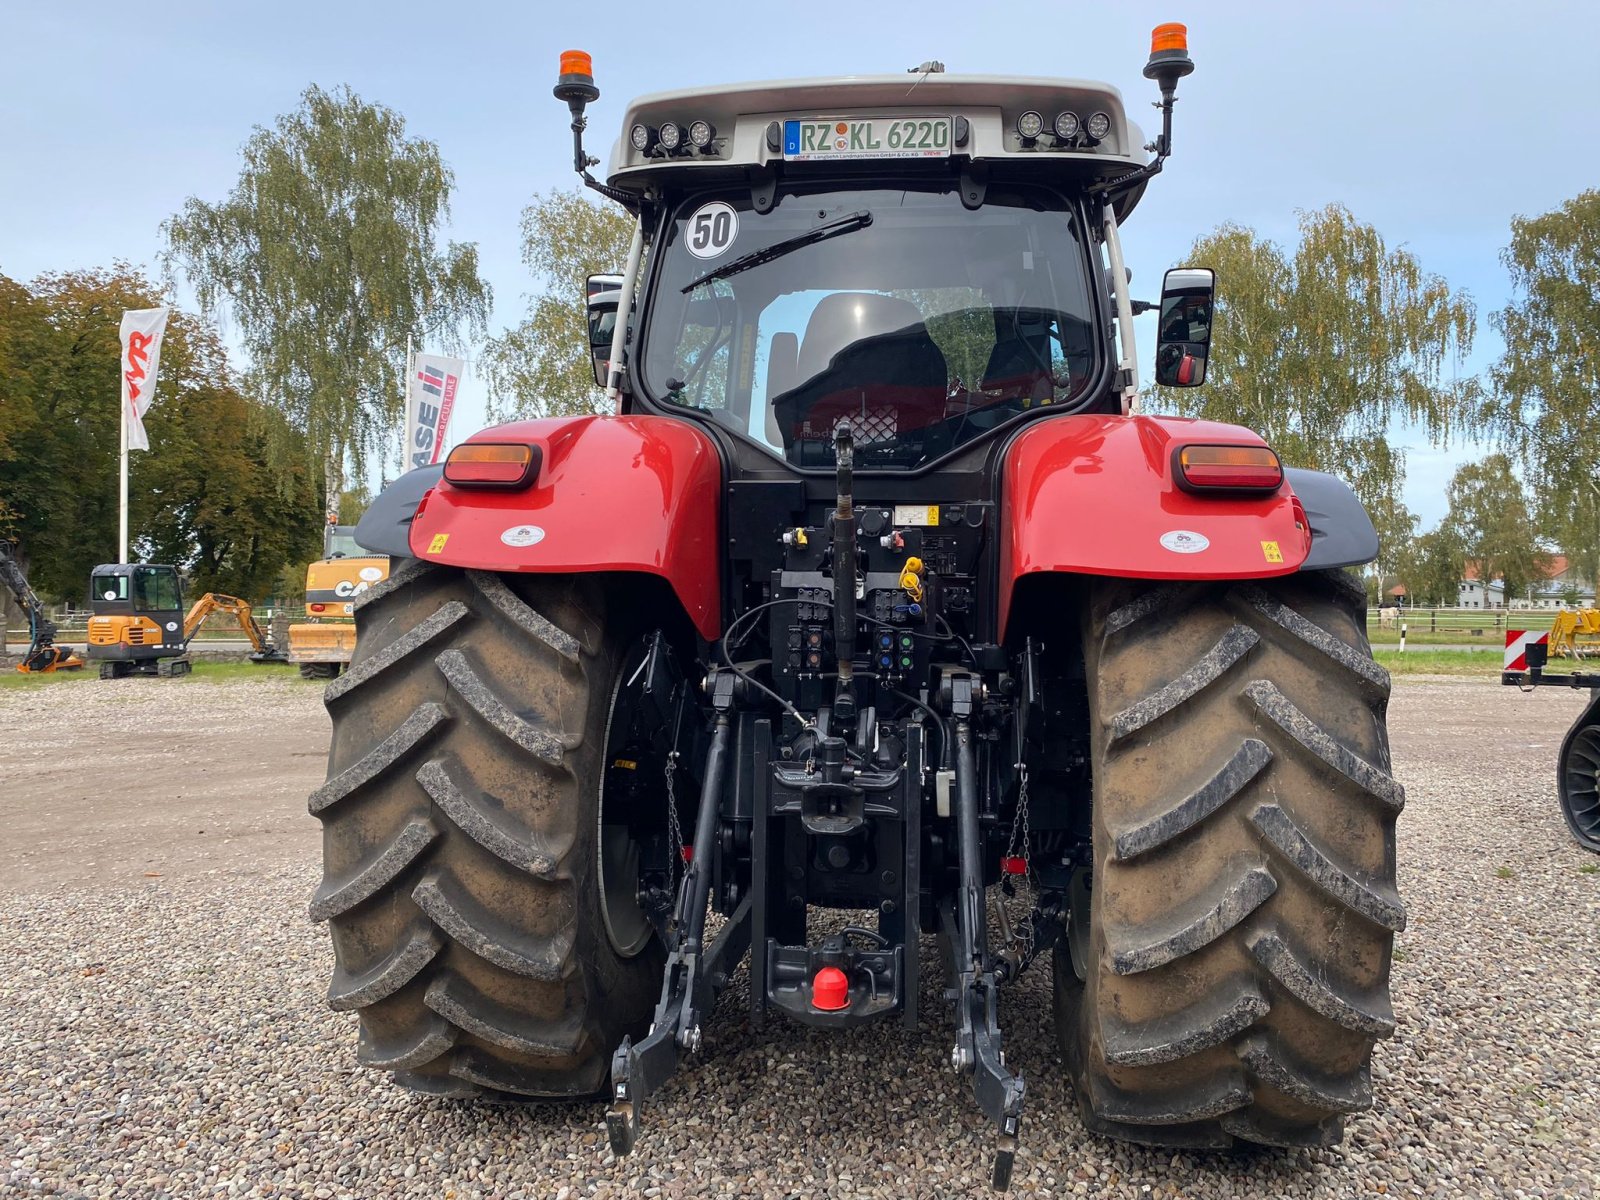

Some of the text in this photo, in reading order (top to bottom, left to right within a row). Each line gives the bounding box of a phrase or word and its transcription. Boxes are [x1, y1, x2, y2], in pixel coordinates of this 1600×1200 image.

[789, 142, 796, 150] D
[801, 121, 948, 151] RZ KL 6220
[693, 211, 732, 250] 50
[412, 401, 439, 469] ASE
[335, 580, 381, 597] CA
